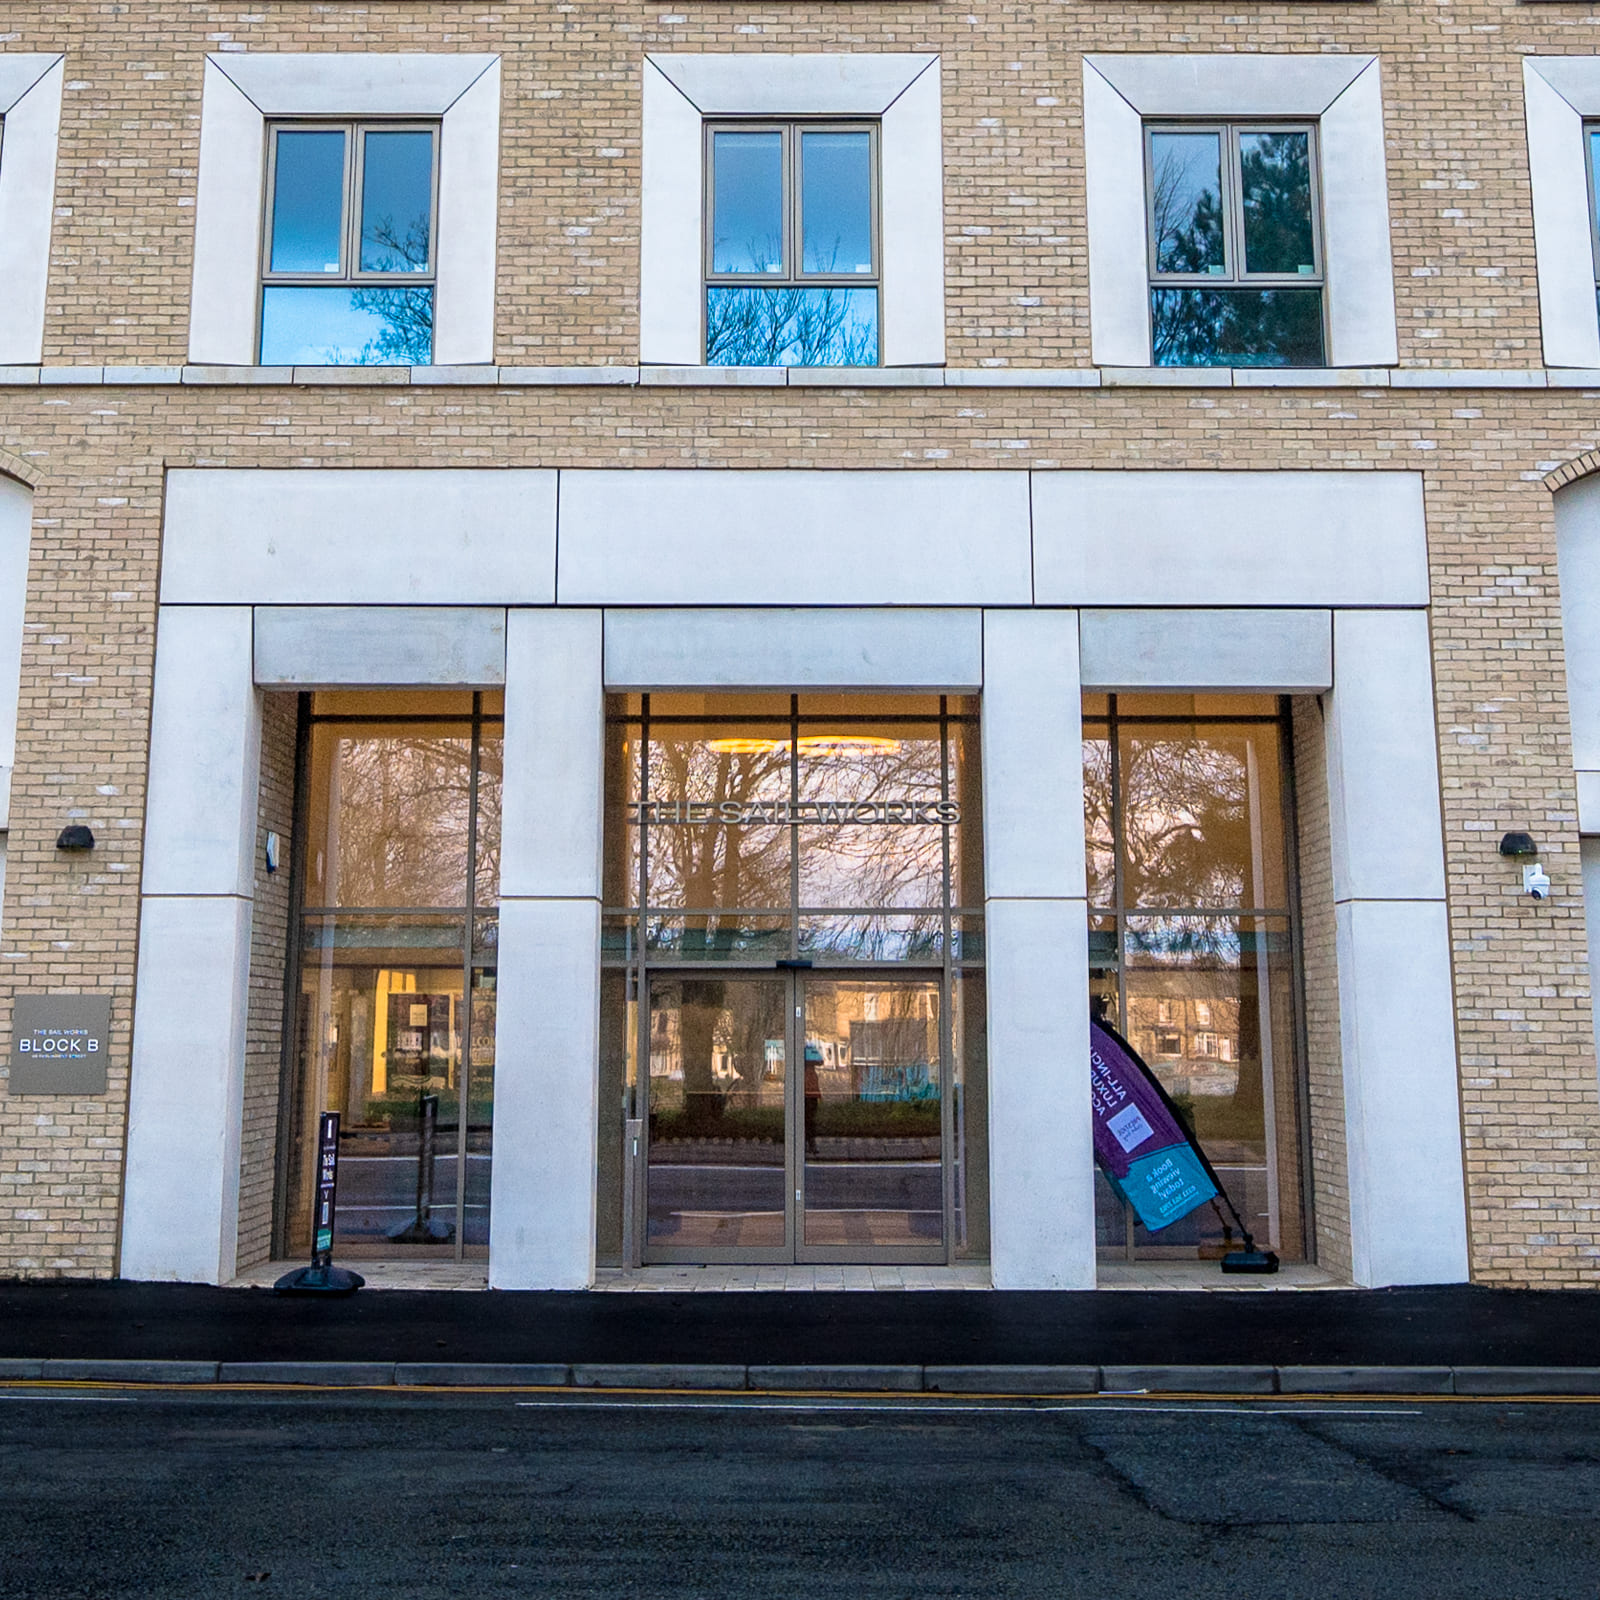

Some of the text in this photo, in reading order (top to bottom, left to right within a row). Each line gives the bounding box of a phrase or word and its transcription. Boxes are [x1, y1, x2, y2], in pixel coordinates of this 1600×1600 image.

[628, 801, 961, 824] THE SAIL WORKS
[19, 1039, 99, 1052] BLOCK B
